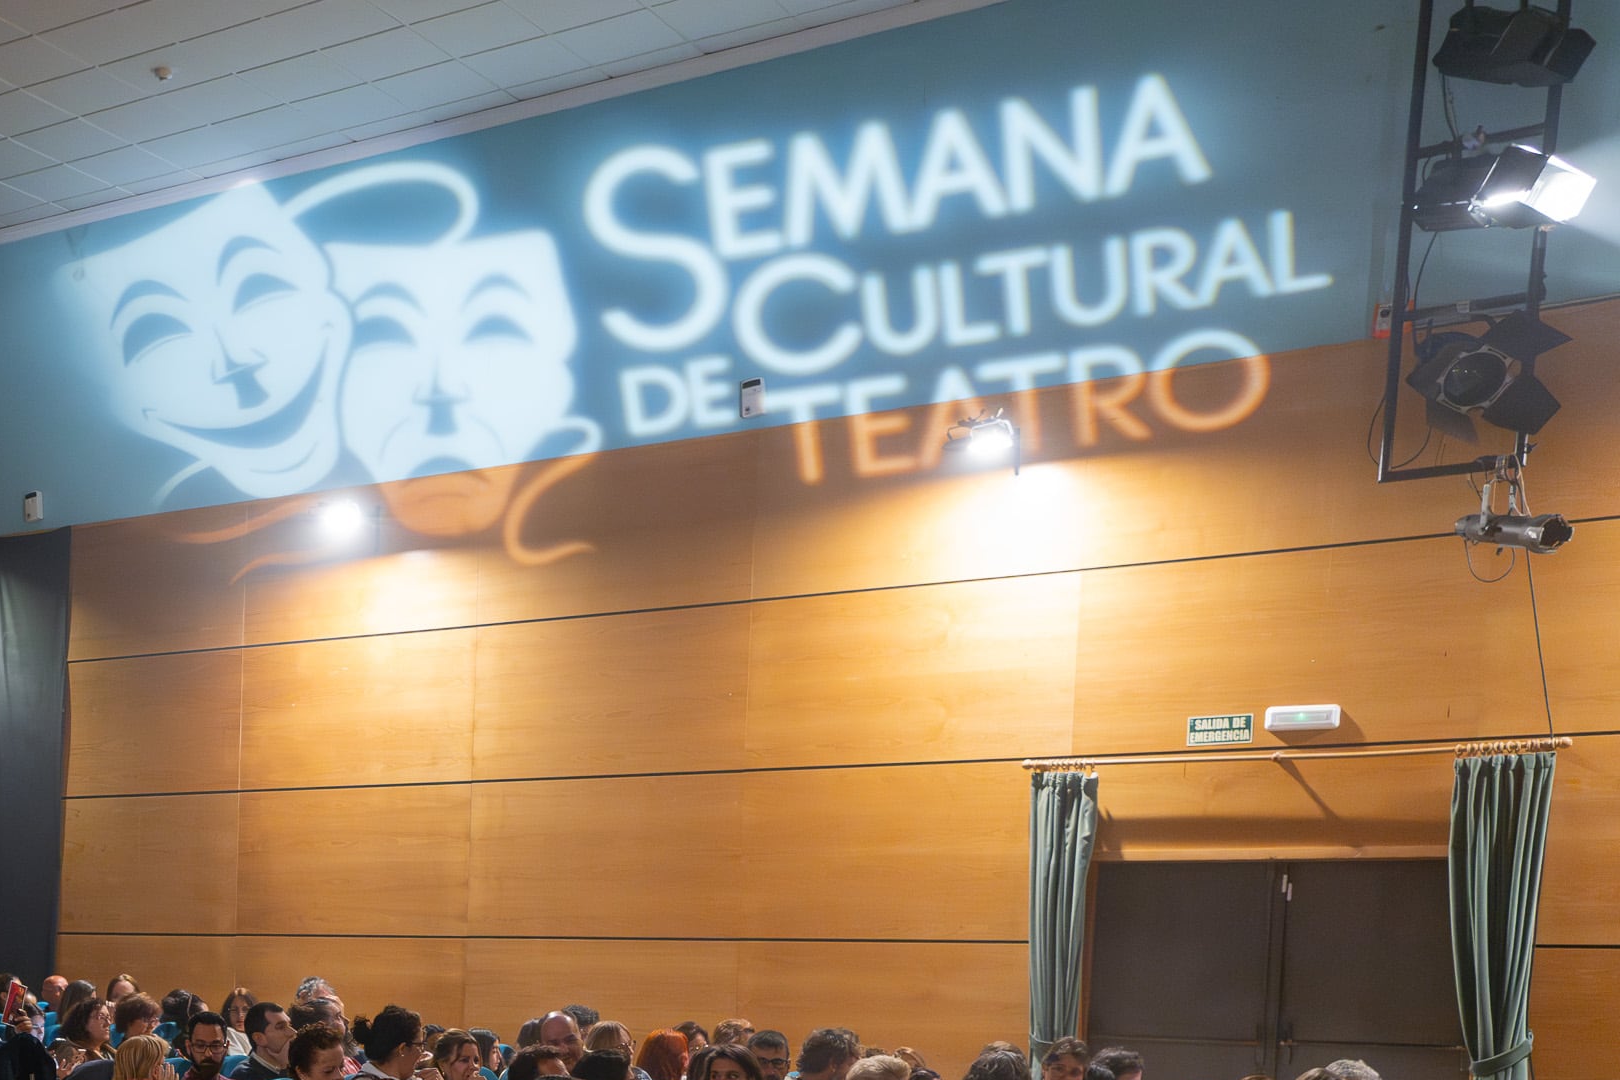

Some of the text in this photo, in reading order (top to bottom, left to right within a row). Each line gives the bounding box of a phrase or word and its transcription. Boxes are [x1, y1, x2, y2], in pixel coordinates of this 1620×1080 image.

[583, 74, 1213, 352] SEMANA
[733, 209, 1334, 374] CULTURAL
[619, 328, 1271, 485] DE TEATRO
[1190, 728, 1250, 743] EMERGENCIA
[1194, 716, 1247, 730] SALIDA DE
